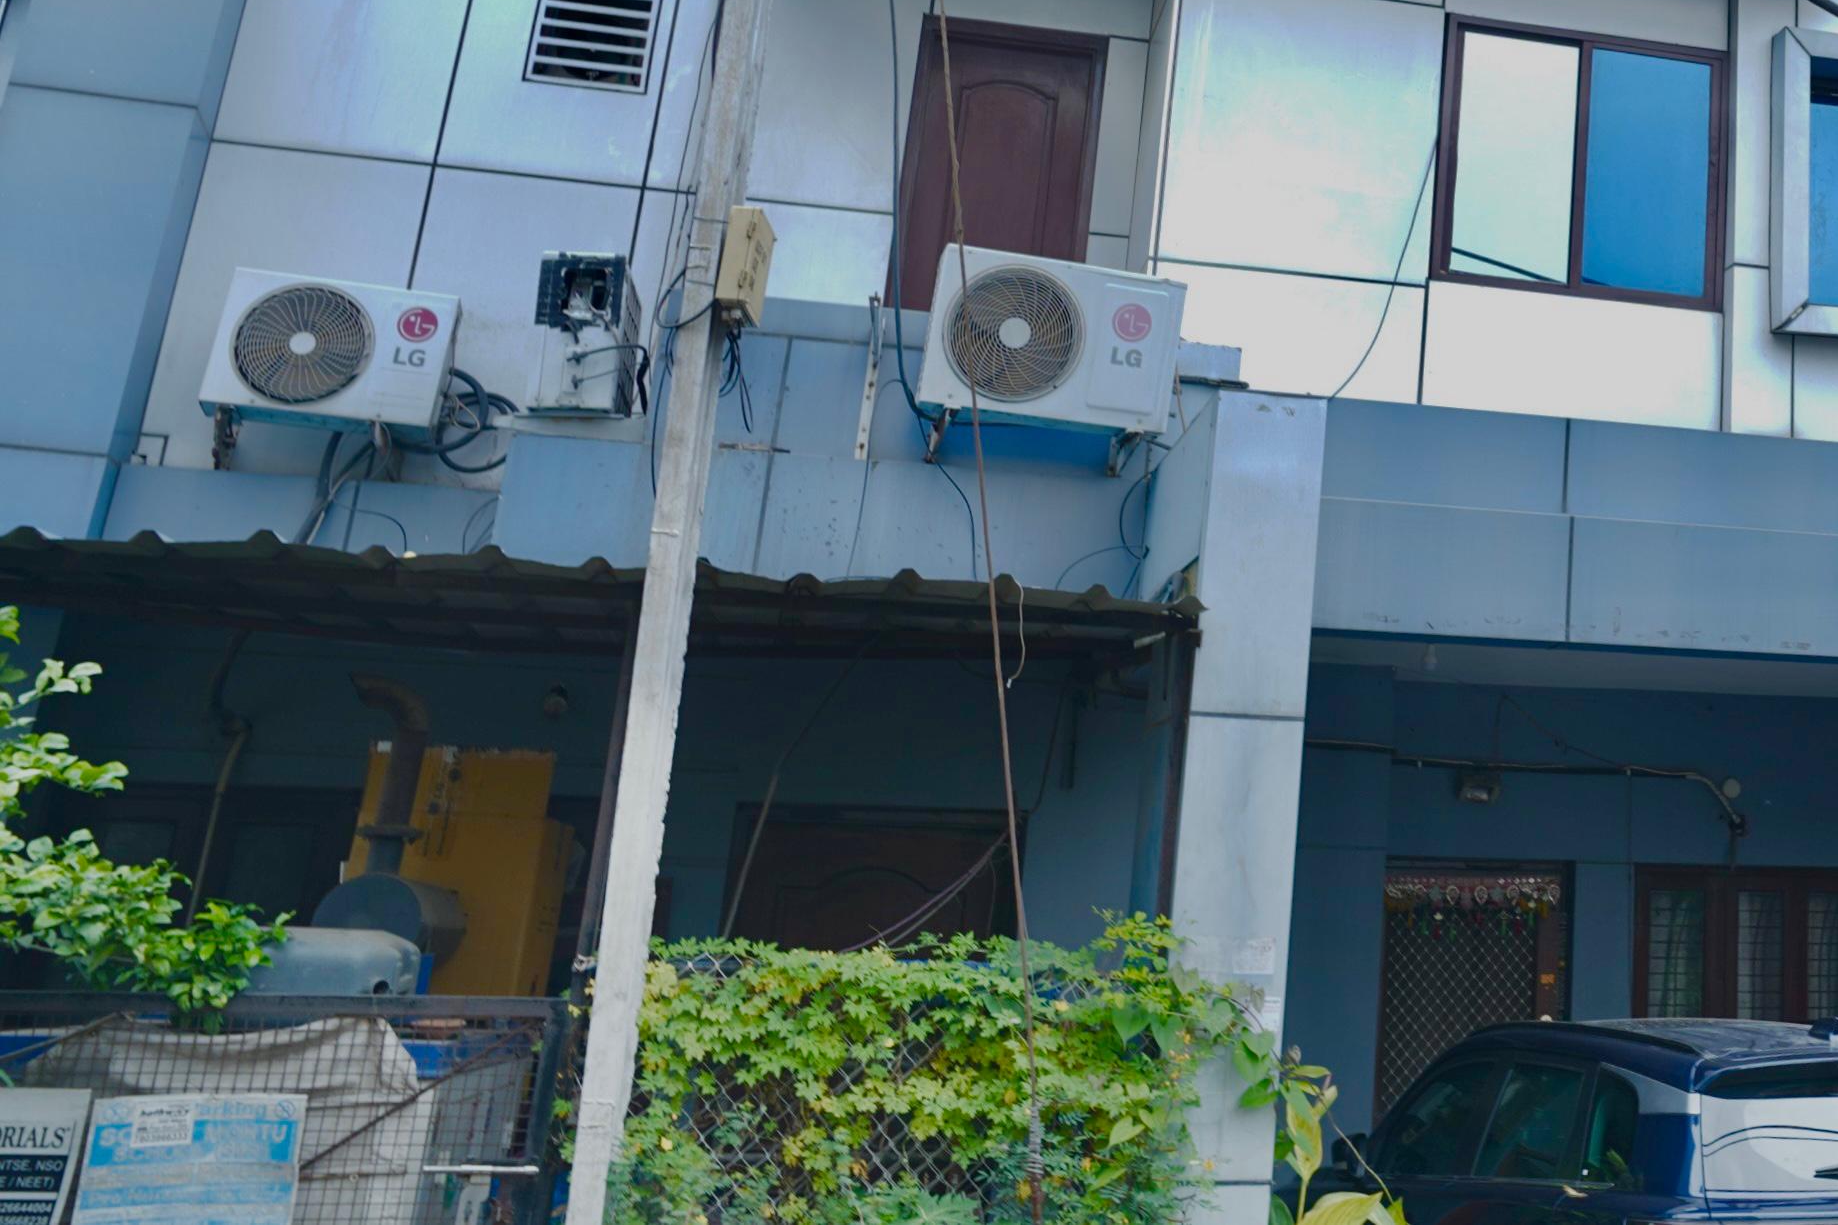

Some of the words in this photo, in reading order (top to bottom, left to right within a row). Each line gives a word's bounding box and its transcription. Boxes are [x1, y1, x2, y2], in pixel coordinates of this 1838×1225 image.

[392, 346, 426, 367] LG
[1110, 346, 1143, 368] LG
[35, 1160, 64, 1171] NSO
